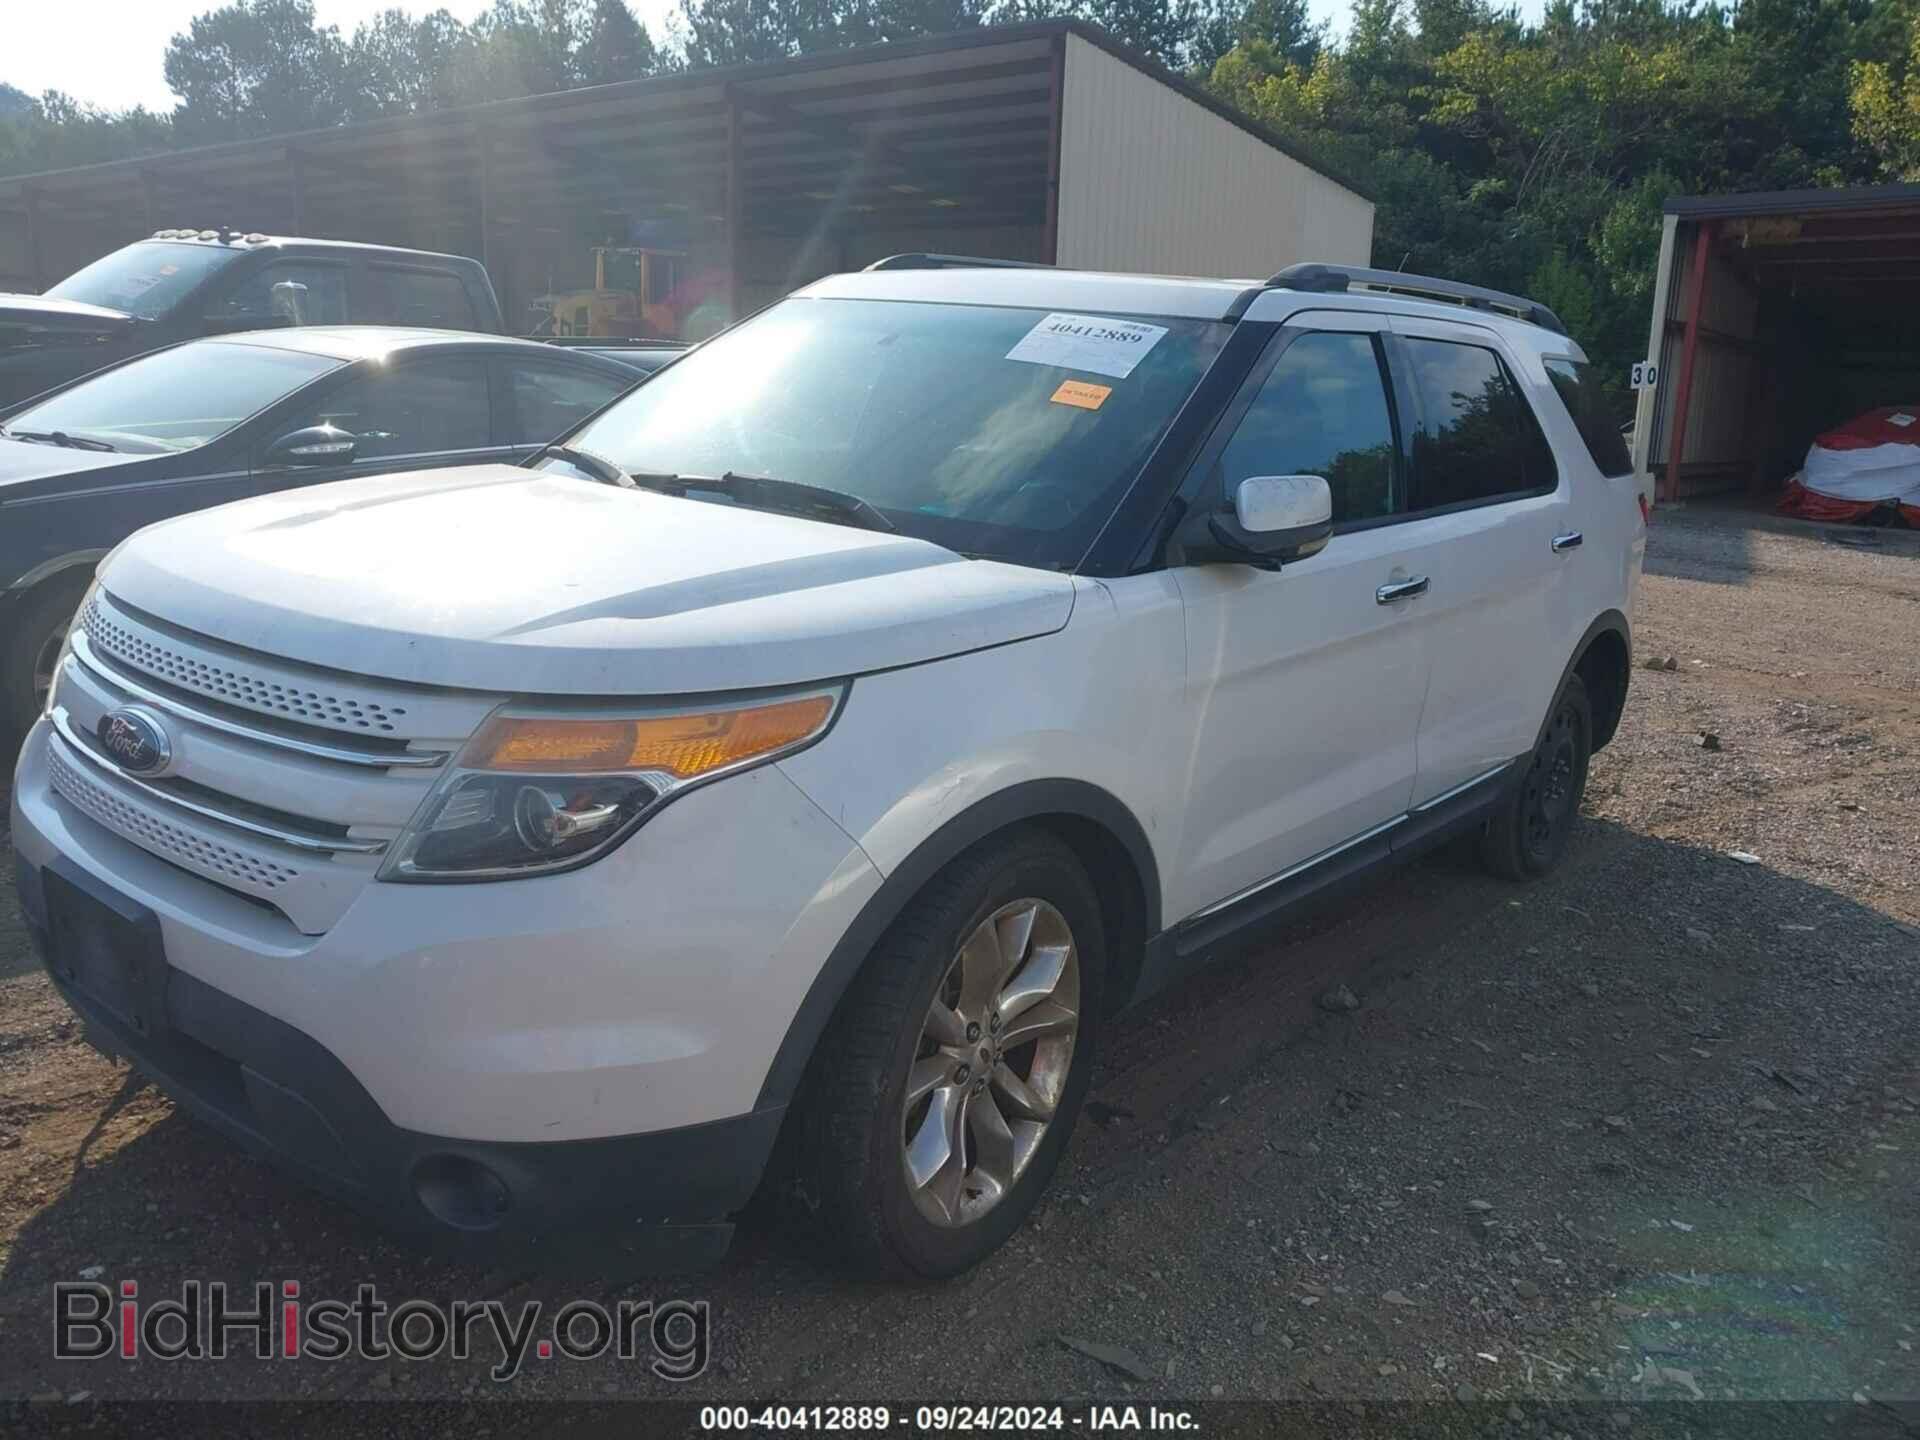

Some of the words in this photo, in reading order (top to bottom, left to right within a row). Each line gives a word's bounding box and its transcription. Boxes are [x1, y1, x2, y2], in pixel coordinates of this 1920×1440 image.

[1049, 322, 1143, 344] 40412889
[1633, 367, 1656, 385] 30
[105, 716, 145, 760] Ford
